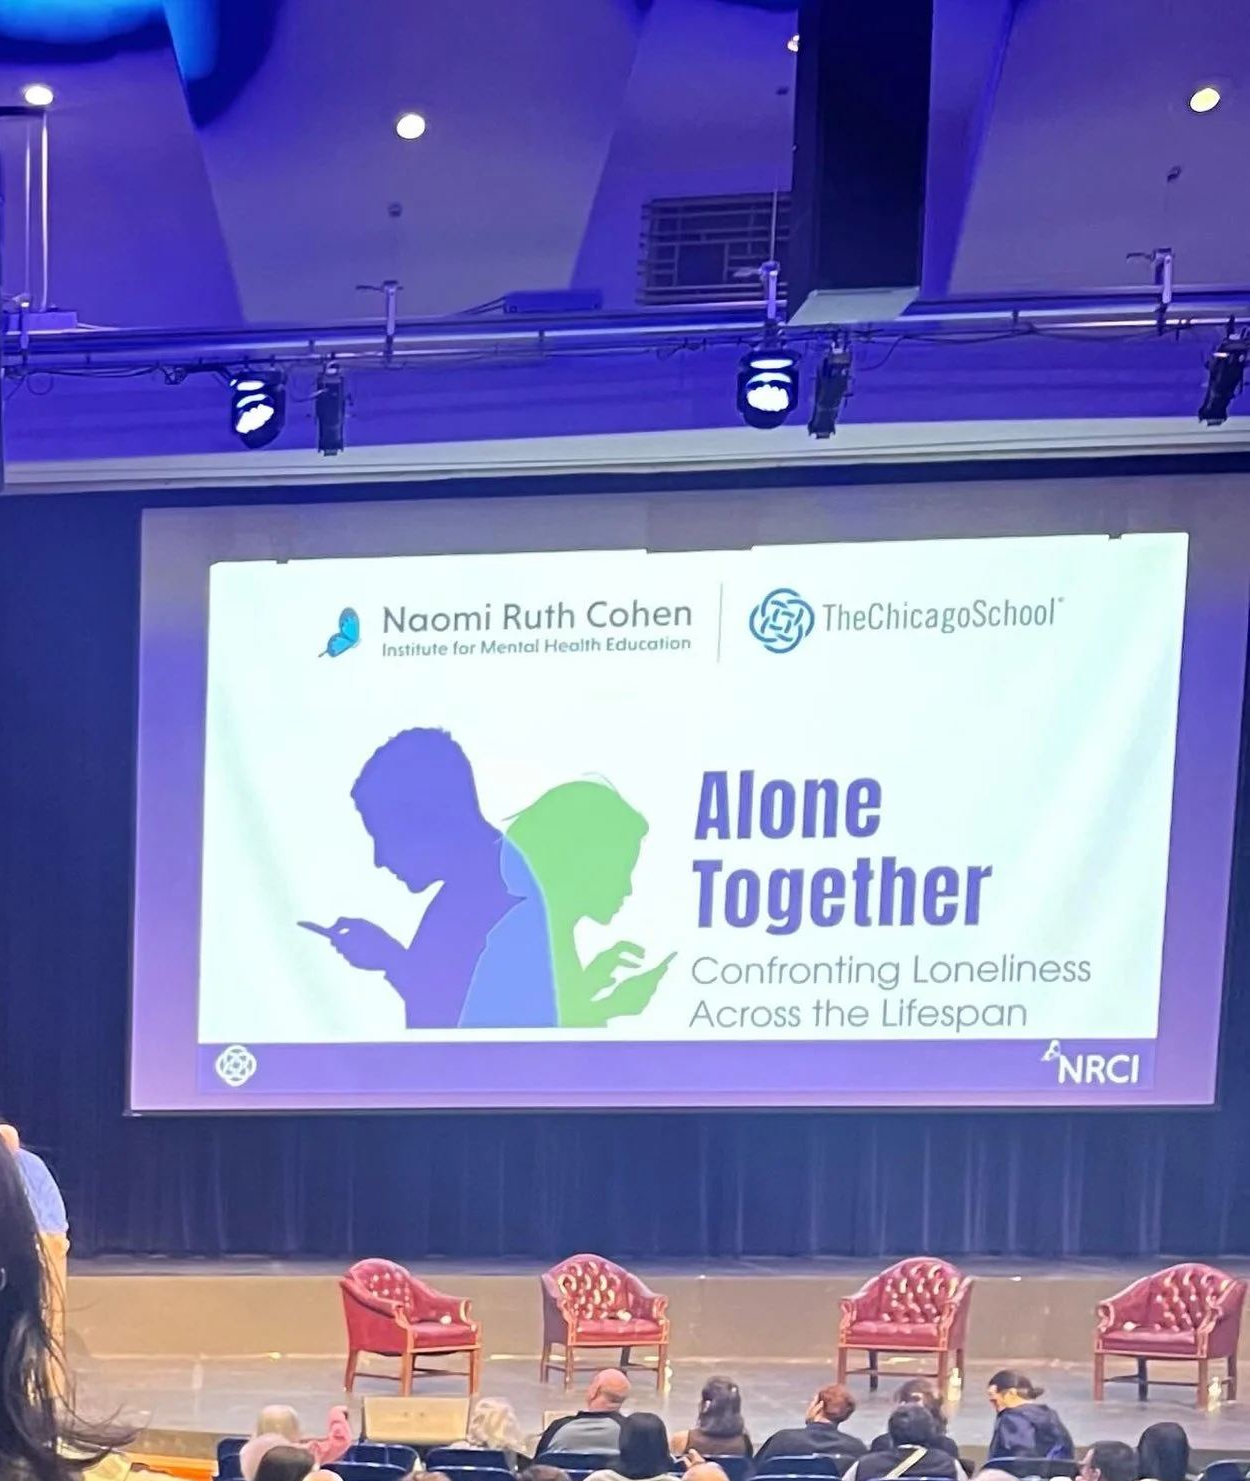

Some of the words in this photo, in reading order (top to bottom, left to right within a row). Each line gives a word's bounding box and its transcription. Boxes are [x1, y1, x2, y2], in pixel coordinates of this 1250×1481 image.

[382, 603, 492, 633] Naomi
[503, 602, 576, 631] Ruth
[586, 599, 692, 629] Cohen
[381, 641, 448, 657] Institute
[452, 640, 475, 655] for
[481, 638, 540, 655] Mental
[544, 637, 602, 653] Health
[606, 635, 692, 651] Education
[693, 769, 882, 840] Alone
[692, 856, 994, 936] Together
[691, 955, 900, 991] Confronting
[913, 953, 1092, 984] Loneliness
[688, 999, 802, 1029] Across
[812, 998, 870, 1027] the
[881, 998, 1028, 1034] Lifespan
[1057, 1053, 1140, 1085] NRCI
